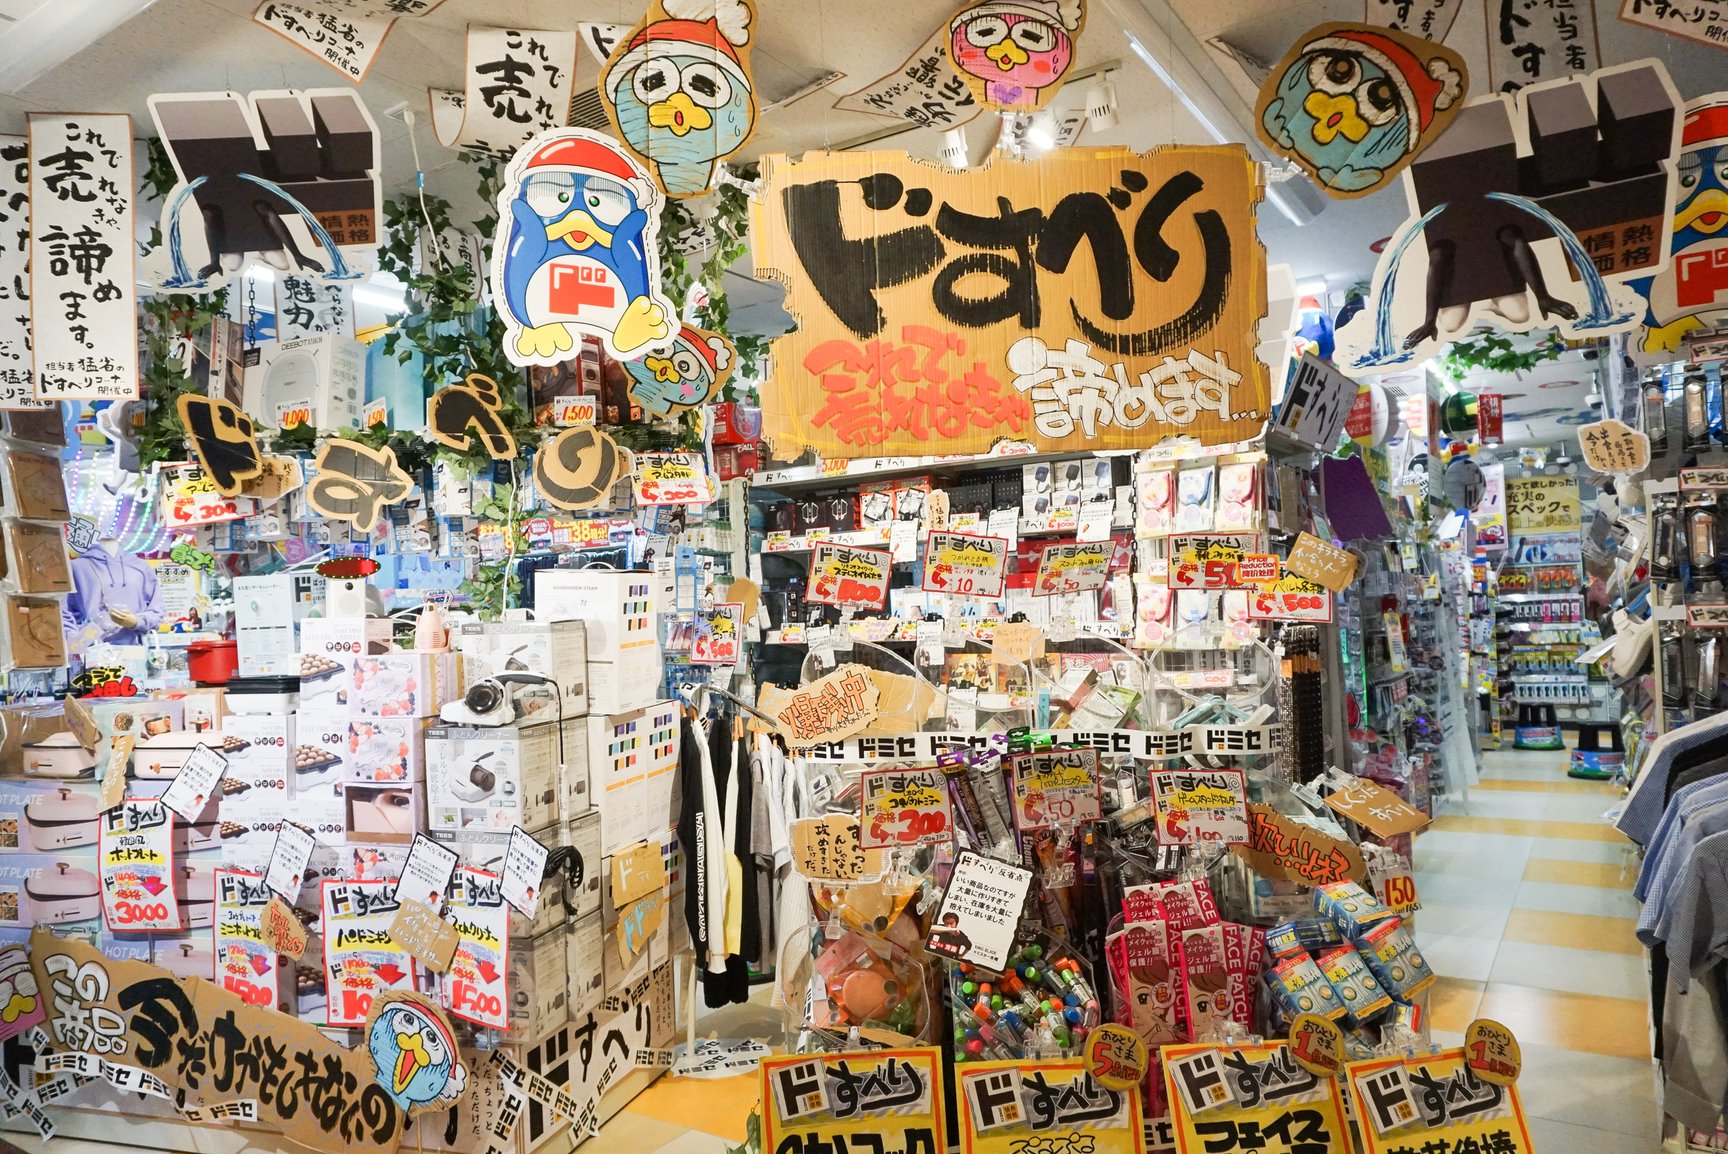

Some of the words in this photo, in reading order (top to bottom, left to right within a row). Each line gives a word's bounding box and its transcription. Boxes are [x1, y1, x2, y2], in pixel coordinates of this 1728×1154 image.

[324, 47, 361, 76] 開催中
[506, 29, 566, 90] これで
[782, 168, 1233, 357] ドすべり
[803, 325, 967, 392] これで
[98, 386, 133, 396] 開催中
[562, 404, 594, 422] 1,500
[635, 454, 690, 471] ドすべり
[1507, 491, 1546, 502] 充実の
[1507, 500, 1571, 516] スペックで
[934, 536, 994, 553] ドすべり
[1047, 544, 1104, 562] ドすべり
[1174, 536, 1242, 553] ドすべり
[819, 547, 878, 567] ドすべり
[1239, 562, 1277, 570] Reduction
[1247, 556, 1269, 564] Price
[957, 577, 973, 593] 10
[1063, 578, 1080, 591] 50
[1241, 570, 1276, 578] 降价处理
[858, 736, 916, 760] ドミセ
[1073, 731, 1131, 753] ドミセ
[1145, 731, 1193, 755] ドミセ
[1206, 729, 1262, 751] ドミセ
[1016, 753, 1083, 779] ドすべり
[867, 772, 935, 799] ドすべり
[1155, 773, 1228, 796] ドすべり
[16, 794, 45, 806] PLATE
[1047, 800, 1075, 821] 50
[106, 802, 168, 832] ドすべり
[896, 809, 947, 842] 300
[109, 848, 159, 862] ホットプレート
[814, 824, 831, 875] 攻めすぎた
[16, 867, 45, 880] PLATE
[955, 875, 1017, 900] いい商品なのですが
[956, 885, 1010, 907] 大量に作りすぎて
[1194, 879, 1216, 920] FACE
[1384, 875, 1416, 907] 150
[947, 891, 1014, 918] しまい、在庫を大量に
[948, 901, 1006, 926] 抱えてしまいました
[1168, 920, 1181, 963] FACE
[1225, 925, 1242, 970] FACE
[1249, 929, 1265, 974] FACE
[104, 946, 134, 959] HOT
[133, 948, 165, 963] PLATE
[452, 979, 502, 1018] 1500
[630, 975, 651, 1008] ドミセ
[1172, 966, 1187, 1019] PATCH
[1230, 973, 1248, 1026] PATCH
[1101, 1029, 1138, 1049] おひとり
[1301, 1019, 1338, 1042] おひとり
[1476, 1024, 1511, 1047] おひとり
[1114, 1046, 1137, 1061] さま
[1317, 1036, 1334, 1052] さま
[1487, 1041, 1508, 1058] さま
[44, 1054, 89, 1073] ドミセ
[488, 1048, 527, 1089] ドミセ
[635, 1049, 655, 1066] ドミセ
[656, 1050, 674, 1066] ドミセ
[596, 1056, 618, 1097] ドミセ
[778, 1057, 924, 1119] ドすべり
[1178, 1045, 1320, 1110] ドすべり
[37, 1079, 70, 1104] ドミセ
[528, 1075, 554, 1103] ドミセ
[974, 1070, 1122, 1131] ドすべり
[1365, 1061, 1502, 1129] ドすべり
[210, 1101, 253, 1120] ドミセ
[554, 1091, 578, 1119] ドミセ
[22, 1099, 54, 1136] ドミセ
[493, 1094, 523, 1142] ドミセ
[573, 1096, 596, 1140] ドミセ
[1193, 1109, 1332, 1153] フェイス
